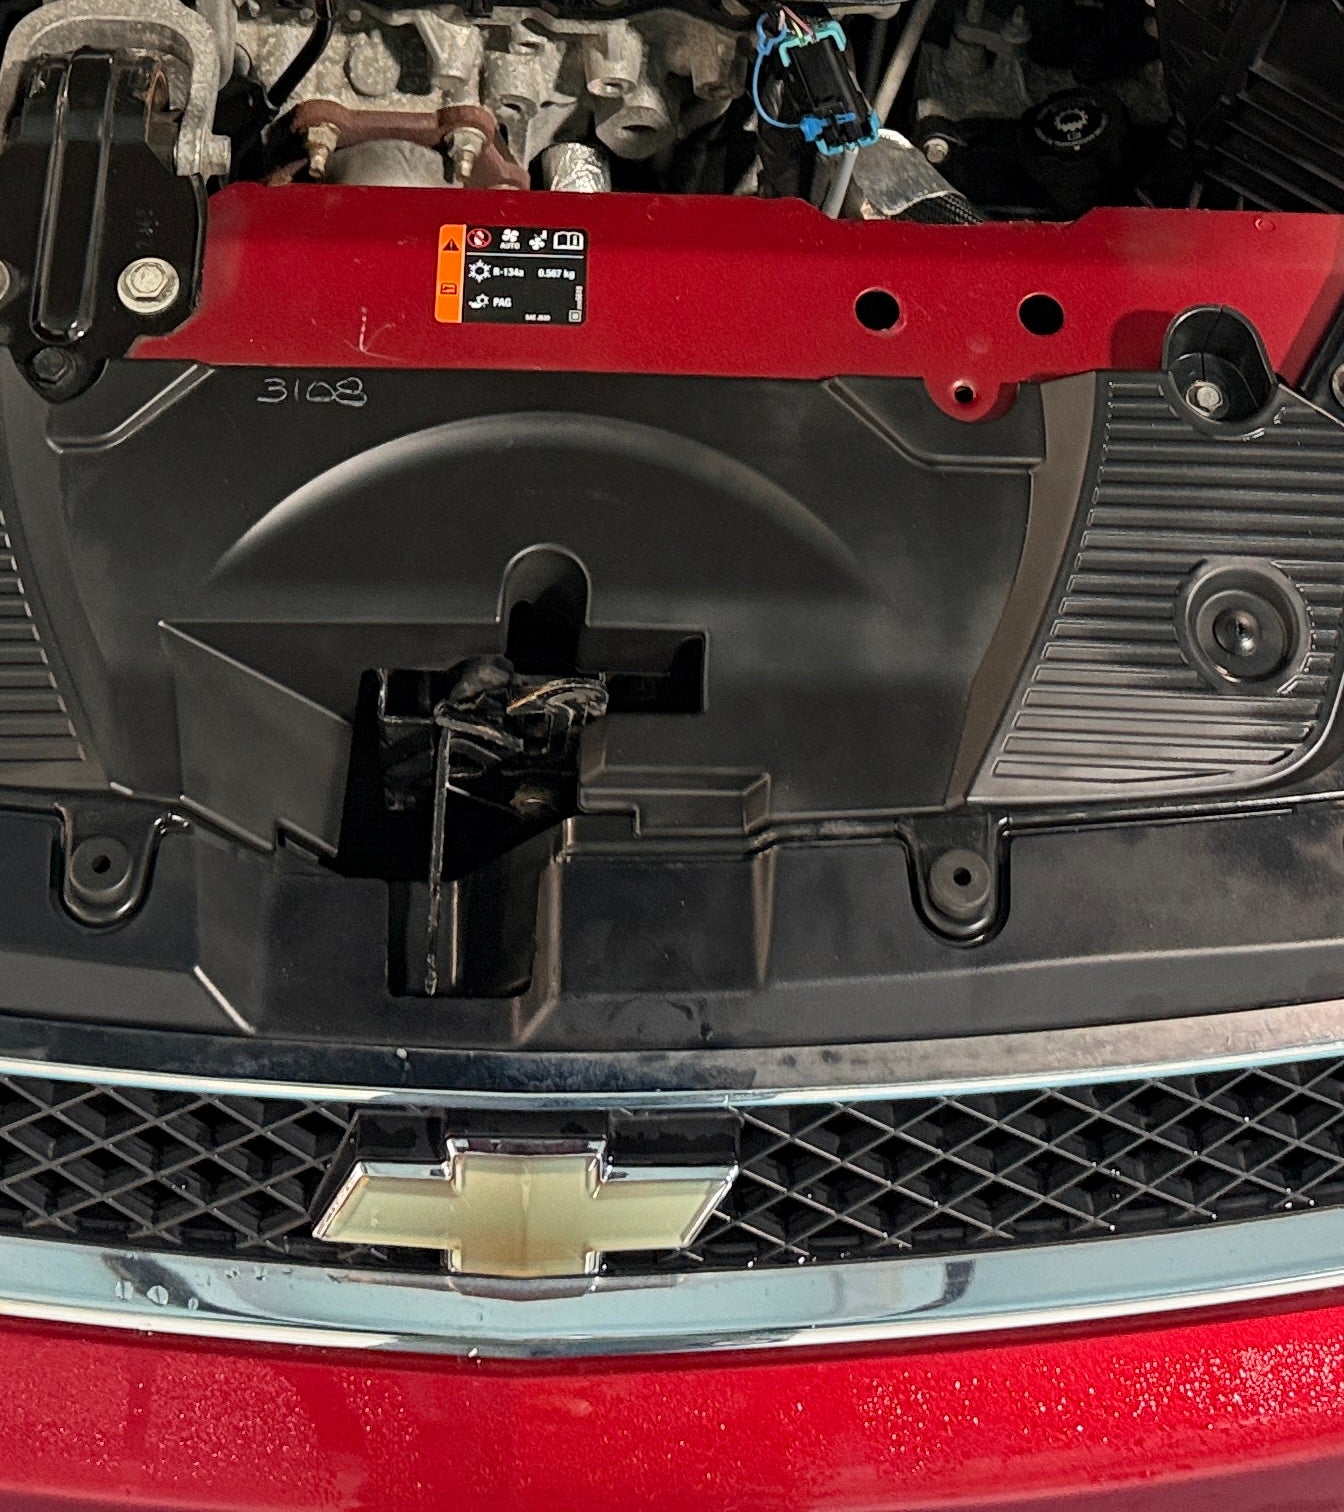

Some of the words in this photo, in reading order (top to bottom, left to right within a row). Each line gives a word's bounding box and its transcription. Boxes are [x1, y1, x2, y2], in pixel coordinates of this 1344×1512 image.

[500, 241, 521, 250] AUTO
[492, 266, 525, 278] R-134a
[563, 268, 576, 280] kg
[492, 297, 512, 308] PAG
[256, 376, 368, 407] 3108
